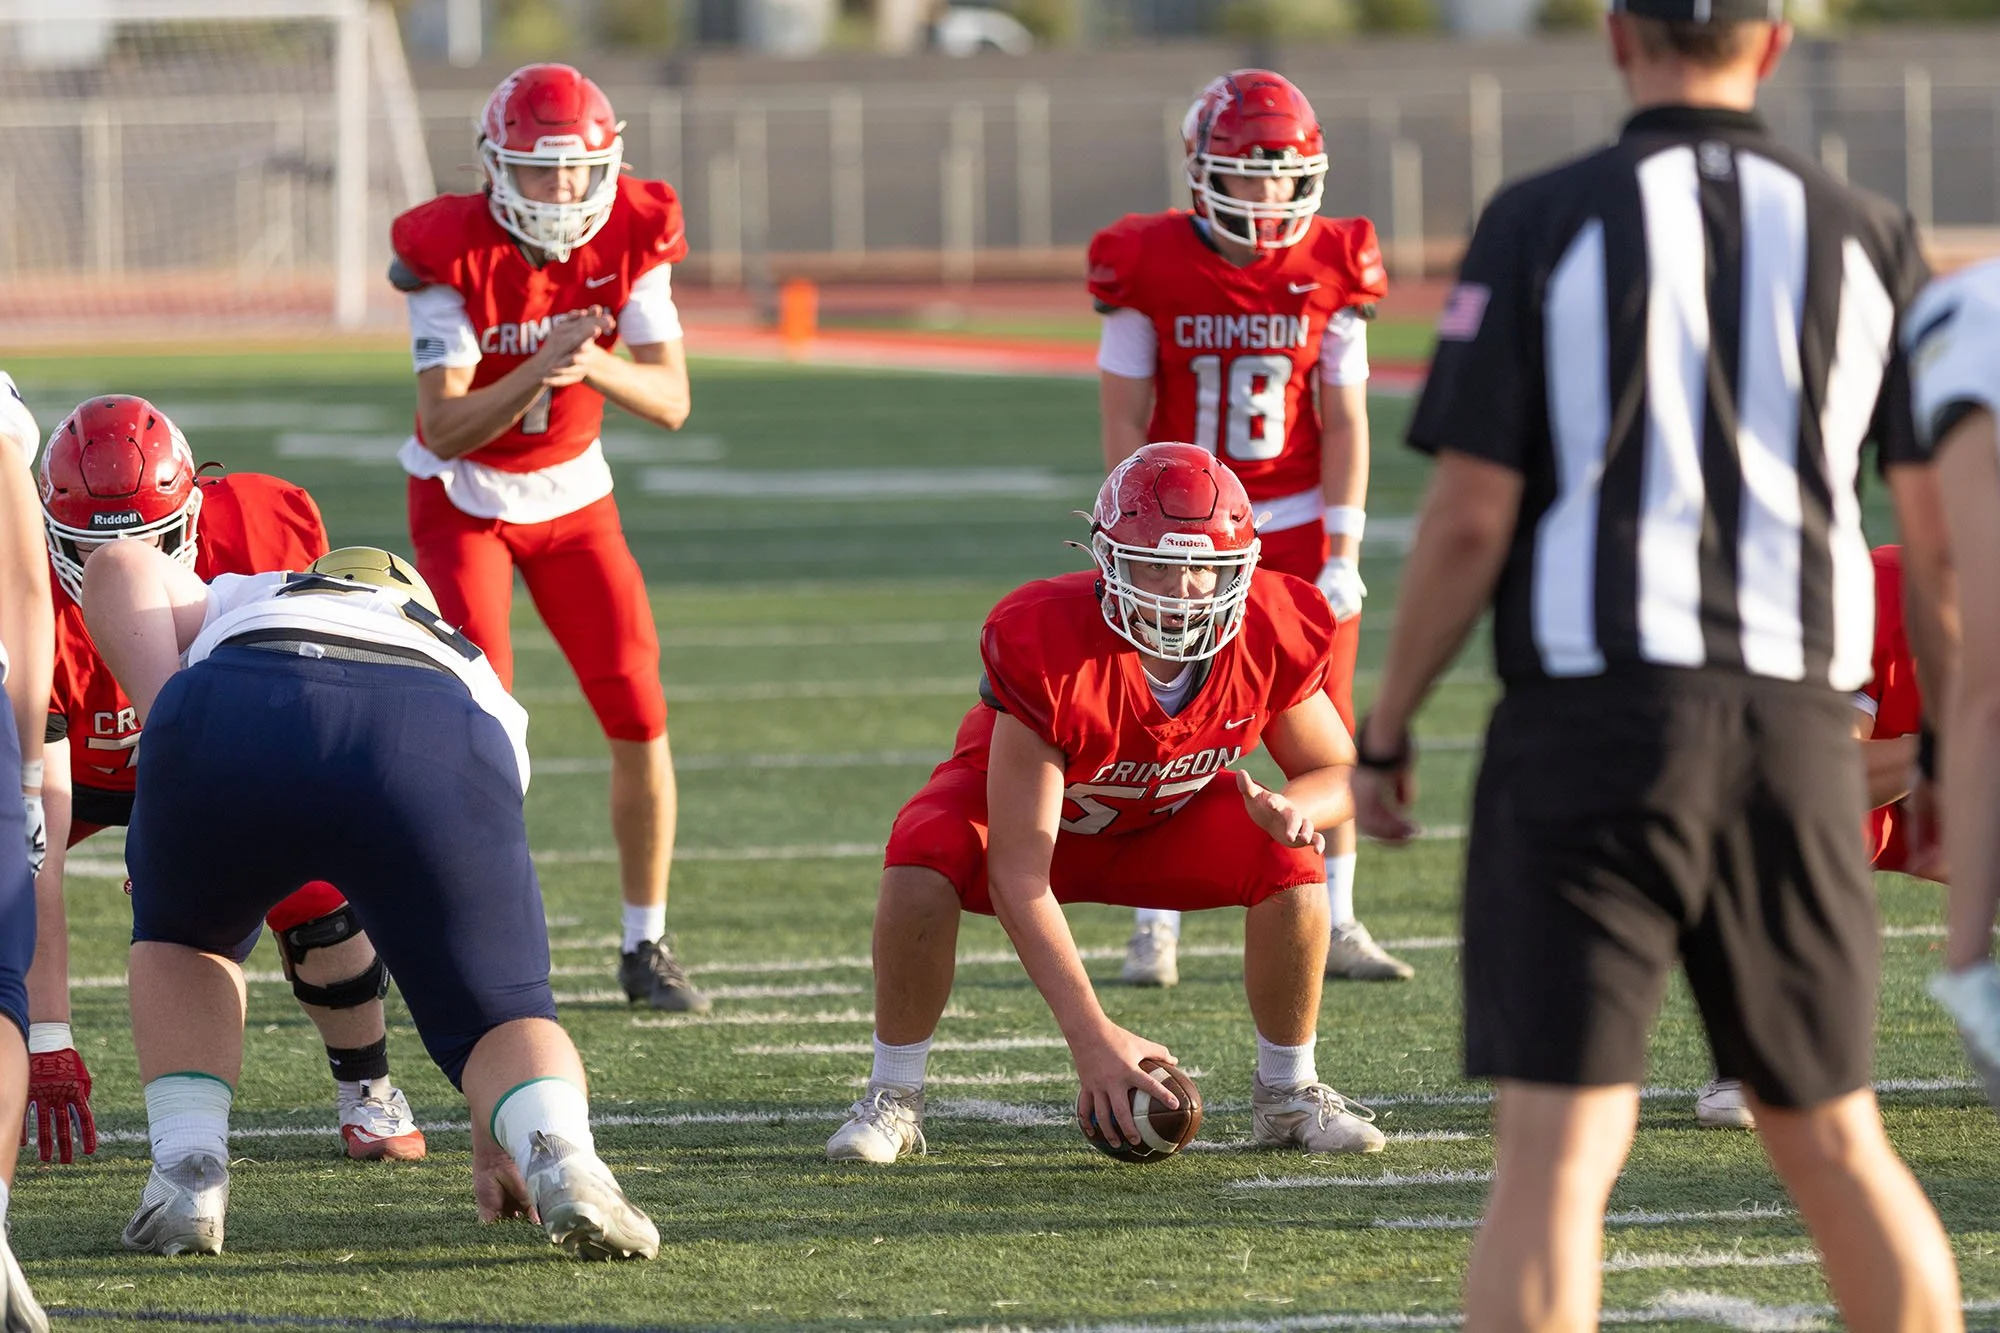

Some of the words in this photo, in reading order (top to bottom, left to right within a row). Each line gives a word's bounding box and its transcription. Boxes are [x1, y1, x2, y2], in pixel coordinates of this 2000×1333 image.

[481, 307, 614, 355] CRIM
[1174, 314, 1310, 349] CRIMSON
[1190, 354, 1293, 461] 18
[94, 512, 137, 525] Riddell
[1089, 746, 1241, 783] CRIMSON
